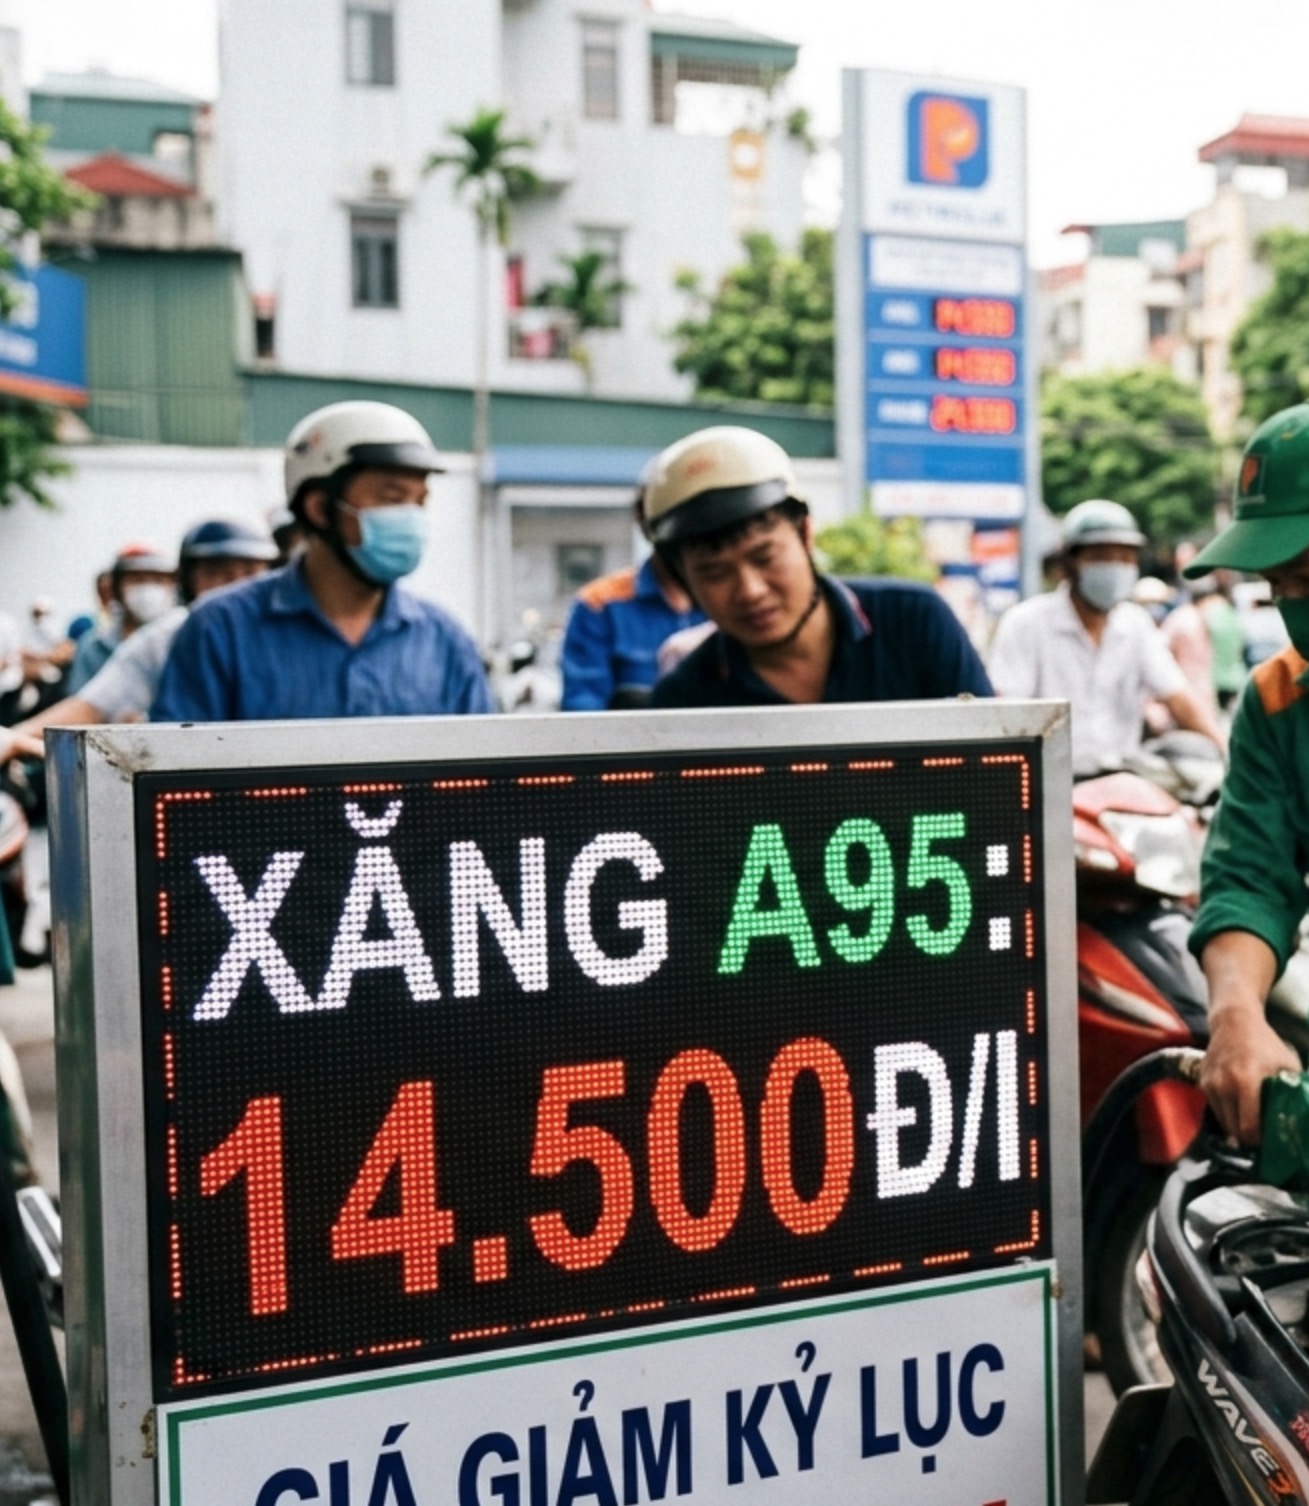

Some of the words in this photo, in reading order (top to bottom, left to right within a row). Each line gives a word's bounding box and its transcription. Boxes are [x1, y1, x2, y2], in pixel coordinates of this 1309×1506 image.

[193, 800, 669, 1021] XĂNG
[457, 1380, 693, 1506] GIẢM
[726, 1341, 832, 1486] KỶ
[860, 1343, 1006, 1475] LỤC
